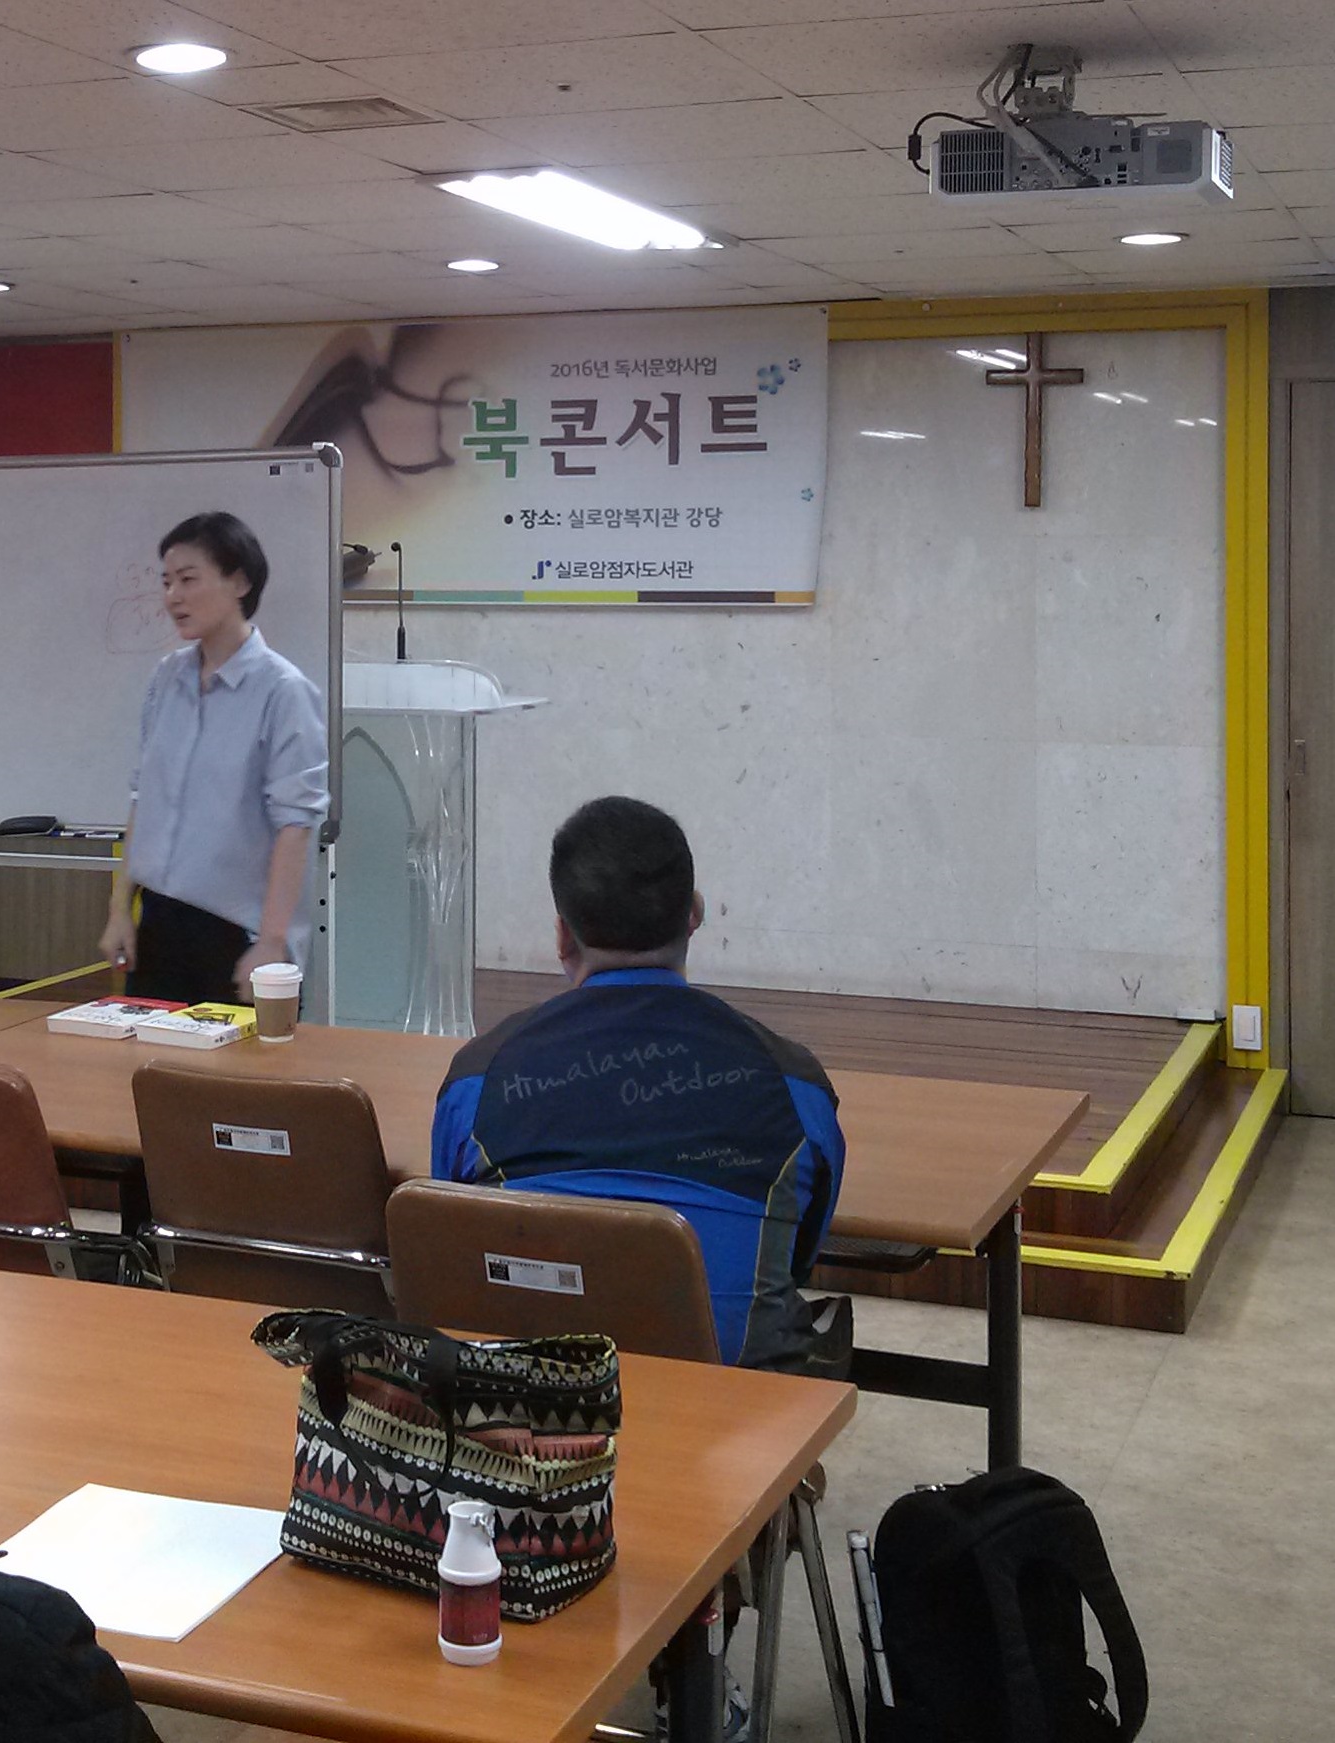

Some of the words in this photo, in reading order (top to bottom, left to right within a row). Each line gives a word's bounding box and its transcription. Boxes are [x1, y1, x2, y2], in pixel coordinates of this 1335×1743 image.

[550, 360, 609, 379] 2016년
[614, 357, 718, 378] 독서문화사업
[519, 508, 562, 530] 장소:
[568, 508, 680, 529] 실로암복지관
[685, 506, 724, 529] 강당
[555, 559, 694, 580] 실로암점자도서관
[619, 1060, 760, 1106] Outdoor
